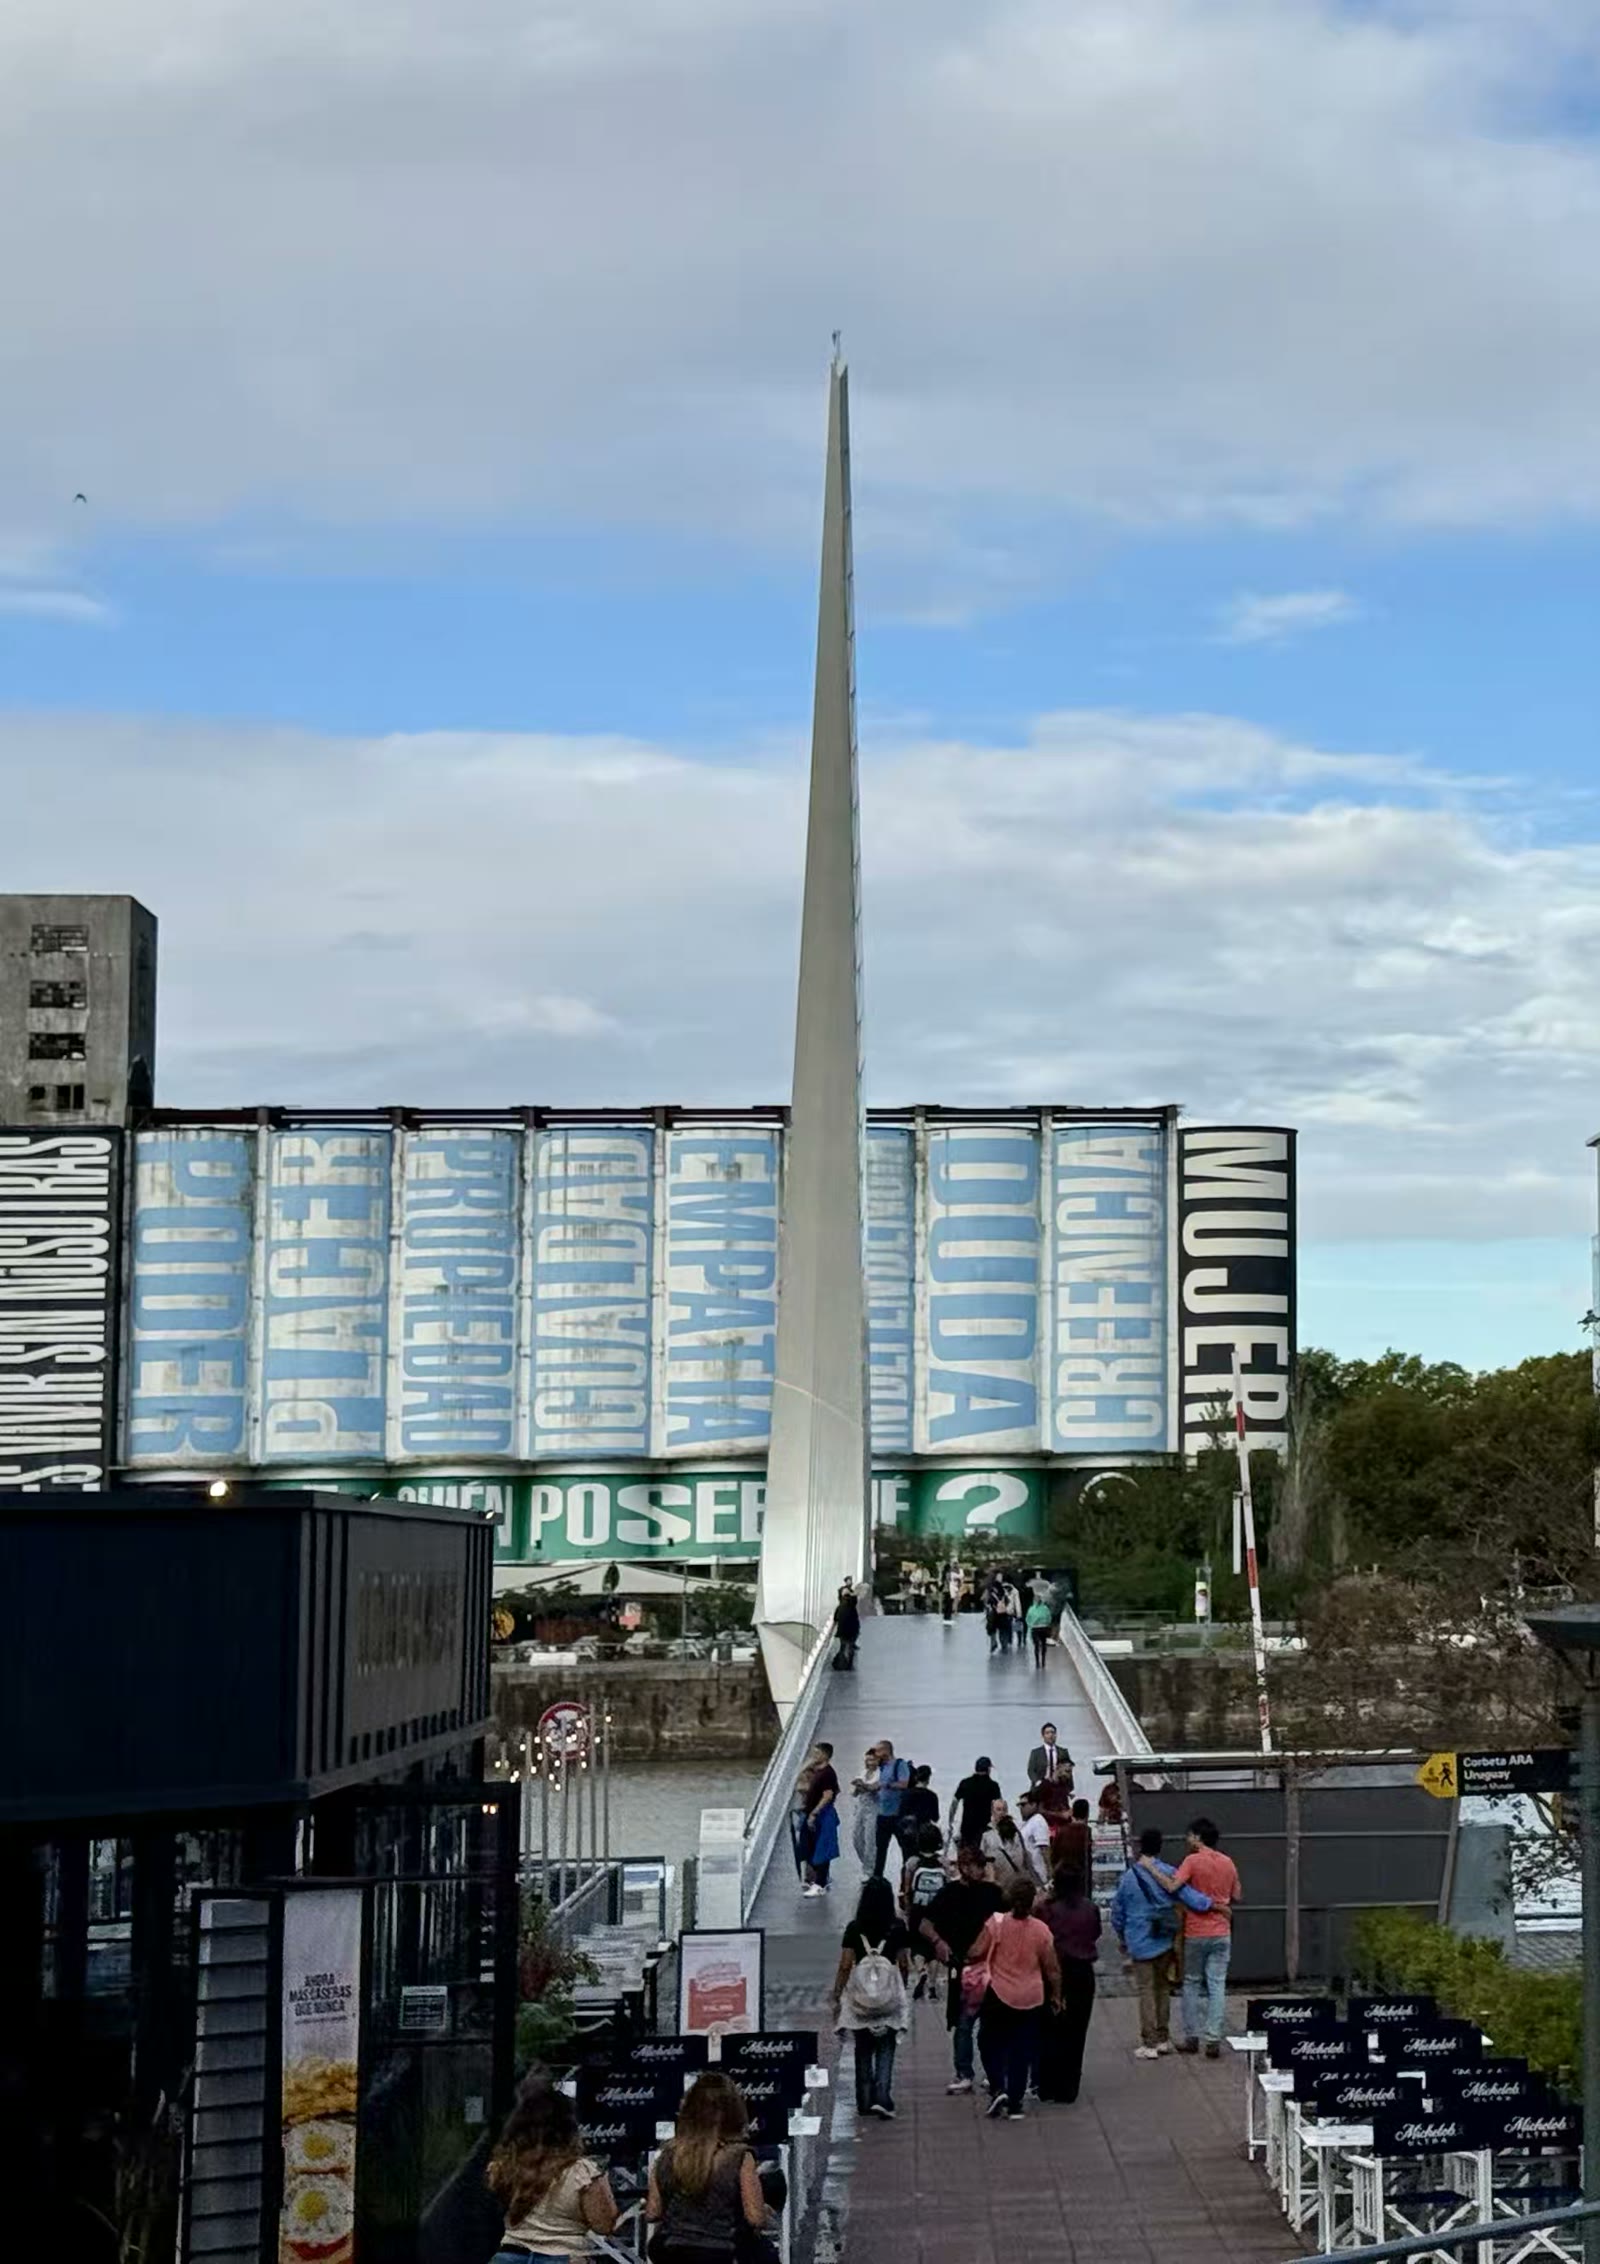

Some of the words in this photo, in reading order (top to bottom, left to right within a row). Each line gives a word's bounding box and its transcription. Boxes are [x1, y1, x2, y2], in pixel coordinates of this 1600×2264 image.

[266, 1136, 384, 1453] PLACER
[534, 1134, 649, 1453] IGUALDAD
[928, 1138, 1038, 1443] DUDA
[1055, 1134, 1163, 1438] CREENCIA
[131, 1141, 249, 1455] PODER
[402, 1138, 516, 1455] PROPIEDAD
[0, 1310, 107, 1364] SIN
[1463, 1756, 1507, 1768] Corbeta
[1508, 1754, 1534, 1766] ARA
[1463, 1769, 1511, 1782] Uruguay
[1291, 2041, 1344, 2056] Michelob
[1403, 2037, 1456, 2053] Michelob
[595, 2086, 655, 2102] Michelob
[1336, 2087, 1396, 2104] Michelob
[1462, 2081, 1519, 2099] Michelob
[1395, 2122, 1456, 2141] Michelob
[1504, 2116, 1567, 2133] Michelob
